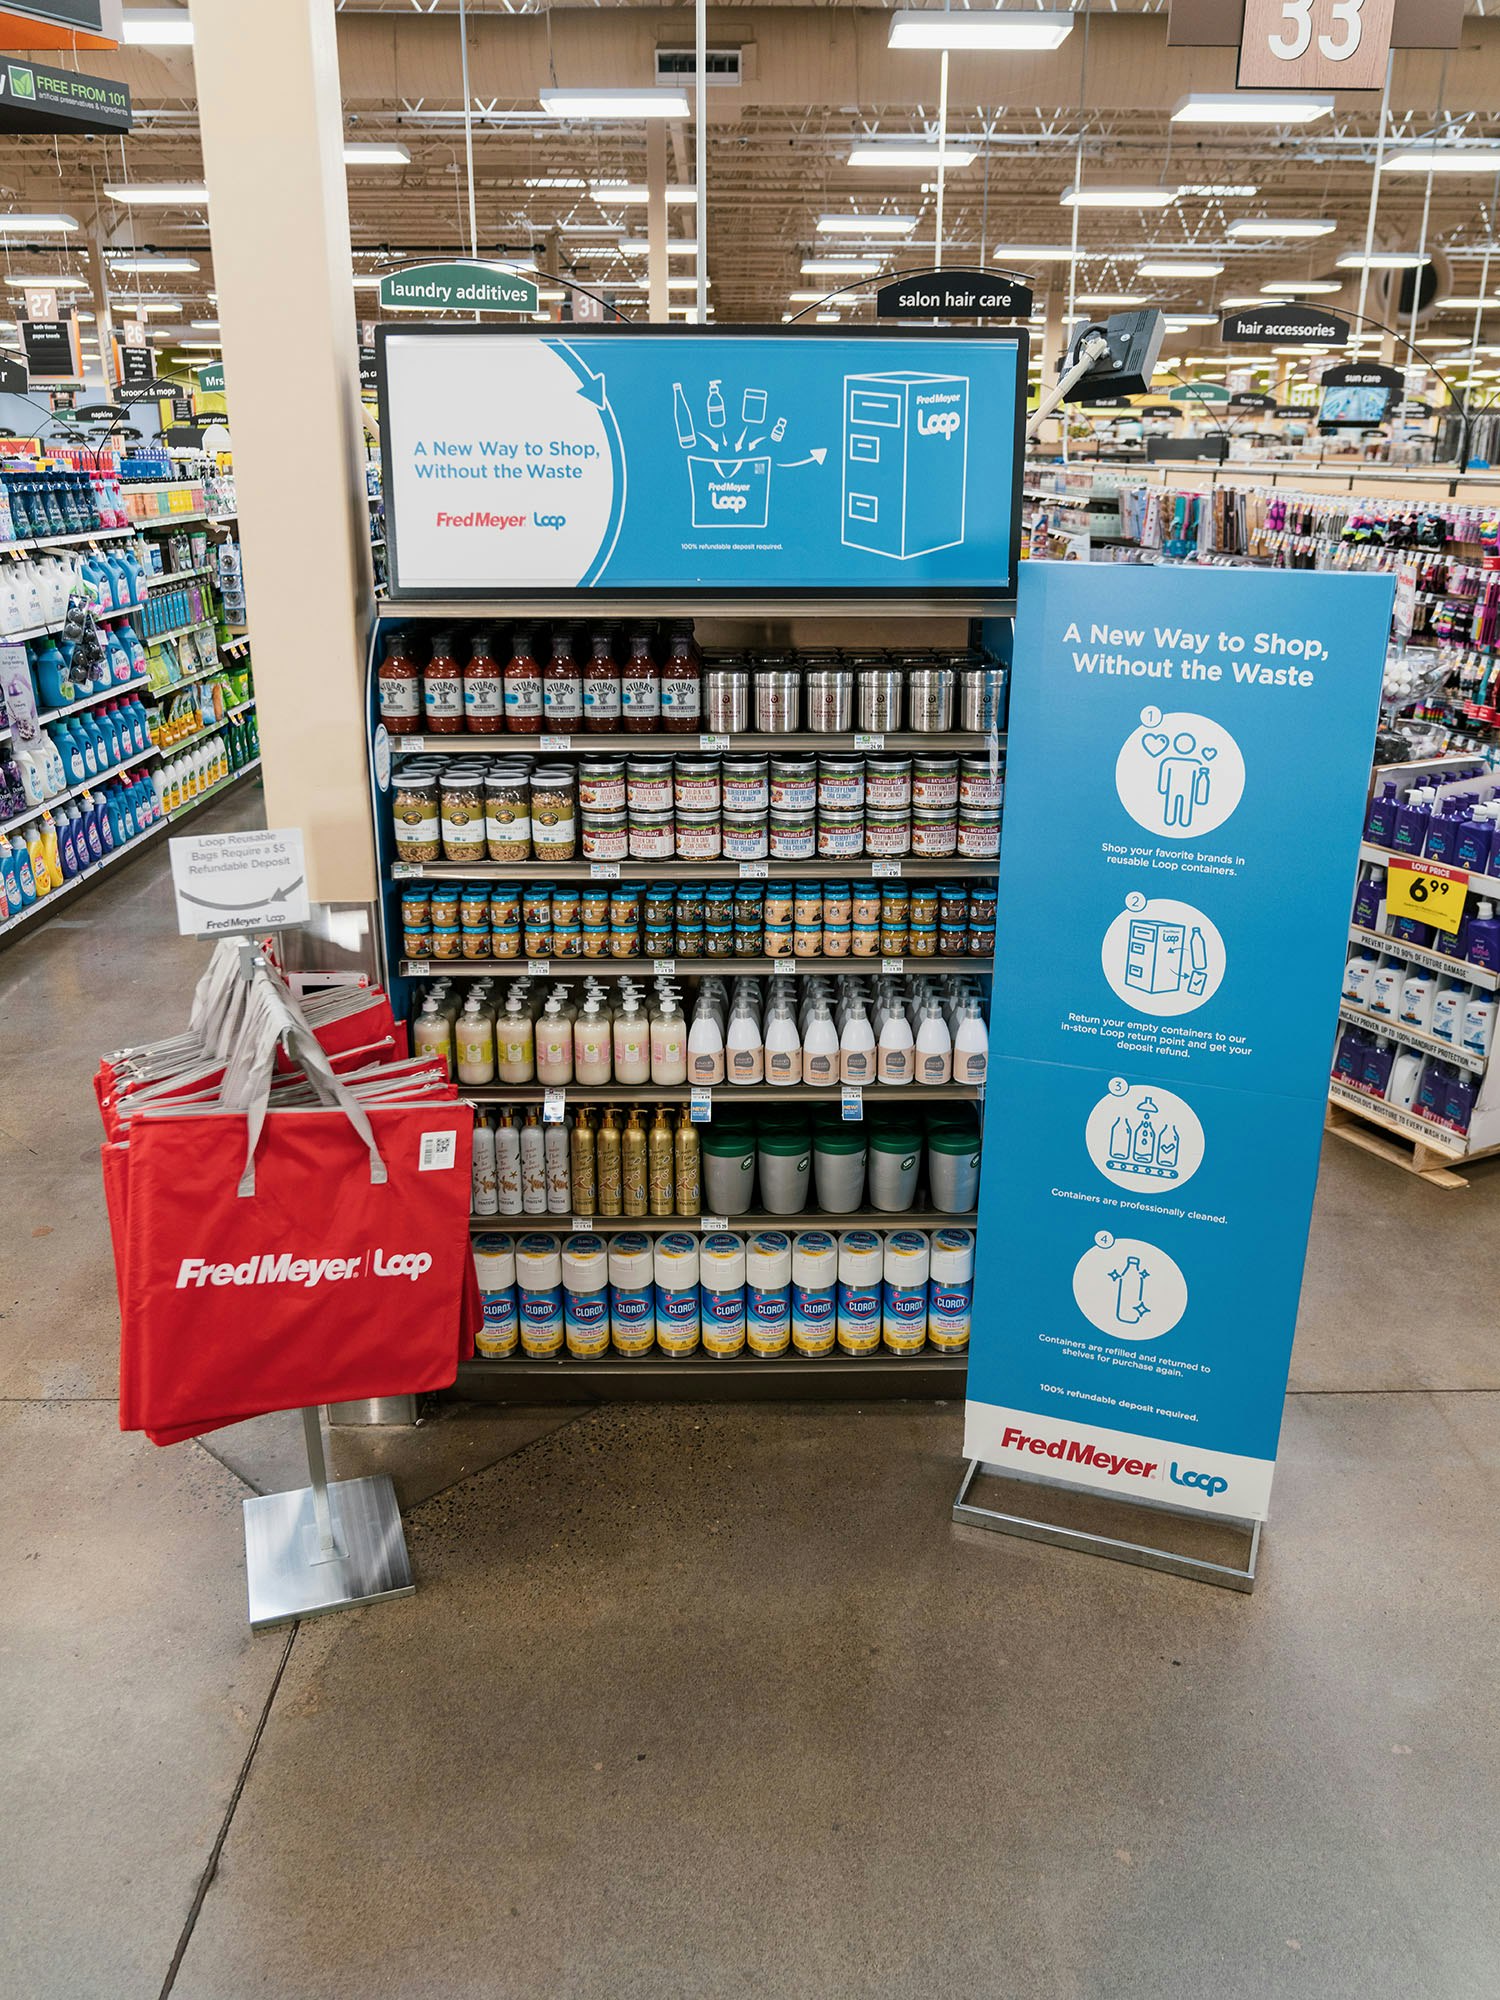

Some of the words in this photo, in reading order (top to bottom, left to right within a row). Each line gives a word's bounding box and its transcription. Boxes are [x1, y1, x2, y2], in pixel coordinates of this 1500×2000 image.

[37, 76, 69, 94] FREE
[71, 83, 106, 102] FROM
[109, 92, 126, 106] 101
[39, 92, 59, 102] artificial
[60, 97, 94, 109] preservatives
[100, 104, 128, 116] ingredients
[391, 281, 451, 300] laundry
[456, 284, 528, 302] additives
[899, 292, 940, 307] salon
[945, 292, 975, 307] hair
[979, 295, 1012, 308] care
[32, 294, 49, 317] 27
[579, 295, 599, 319] 31
[127, 325, 142, 343] 26
[1237, 321, 1263, 337] hair
[1266, 322, 1335, 338] accessories
[1345, 375, 1361, 383] sun
[1363, 375, 1381, 383] care
[121, 389, 147, 397] brooms
[156, 388, 176, 397] mops
[917, 409, 960, 440] Loop
[414, 442, 427, 456] A
[434, 442, 472, 456] New
[479, 442, 518, 459] Way
[524, 442, 543, 456] to
[549, 442, 600, 459] Shop,
[416, 464, 487, 478] Without
[494, 464, 522, 478] the
[527, 465, 582, 479] Waste
[712, 492, 746, 513] Loop
[534, 512, 566, 530] Loop
[1062, 623, 1081, 643] A
[1090, 624, 1145, 646] New
[1154, 627, 1210, 654] Way
[1218, 632, 1245, 652] to
[1253, 633, 1329, 661] Shop,
[1072, 653, 1173, 678] Without
[1181, 658, 1222, 681] the
[1232, 662, 1314, 687] Waste
[1148, 711, 1152, 722] 1
[200, 838, 225, 848] Loop
[229, 833, 276, 845] Reusable
[192, 851, 218, 862] Bags
[222, 847, 261, 858] Require
[273, 844, 285, 853] $5
[1102, 843, 1127, 855] Shop
[1130, 847, 1153, 856] your
[1156, 848, 1194, 860] favorite
[1197, 852, 1232, 864] brands
[1236, 856, 1245, 866] in
[189, 861, 248, 874] Refundable
[252, 857, 290, 869] Deposit
[1107, 856, 1149, 867] reusable
[1152, 860, 1178, 871] Loop
[1181, 862, 1237, 876] containers.
[1411, 862, 1427, 872] LOW
[1429, 866, 1450, 878] PRICE
[1132, 896, 1139, 907] 2
[266, 914, 285, 923] Loop
[1163, 933, 1179, 945] Loop
[1362, 936, 1384, 948] PREVENT
[1393, 947, 1400, 955] TO
[1422, 956, 1442, 970] FUTURE
[1068, 1012, 1100, 1024] Return
[1103, 1018, 1124, 1028] your
[1127, 1022, 1158, 1034] empty
[1162, 1026, 1212, 1039] containers
[1216, 1032, 1225, 1041] to
[1229, 1035, 1246, 1044] our
[1061, 1022, 1097, 1034] in-store
[1100, 1028, 1124, 1039] Loop
[1128, 1031, 1156, 1042] return
[1159, 1035, 1185, 1047] point
[1188, 1040, 1206, 1050] and
[1209, 1043, 1226, 1053] get
[1229, 1046, 1252, 1056] your
[1116, 1041, 1153, 1053] deposit
[1156, 1046, 1190, 1058] refund.
[1411, 1037, 1436, 1053] DANDRUFF
[1438, 1047, 1469, 1066] PROTECTION
[1115, 1081, 1121, 1092] 3
[1331, 1086, 1341, 1095] ADD
[1342, 1089, 1372, 1108] MIRACULOUS
[1373, 1104, 1398, 1121] MOISTURE
[1399, 1116, 1405, 1124] TO
[1406, 1119, 1423, 1131] EVERY
[1424, 1128, 1439, 1138] WASH
[1440, 1134, 1451, 1144] DAY
[1051, 1188, 1100, 1203] Containers
[1103, 1197, 1117, 1206] are
[1120, 1199, 1185, 1218] professionally
[1188, 1210, 1228, 1224] cleaned.
[1100, 1235, 1108, 1244] 4
[373, 1248, 432, 1280] Loop
[483, 1303, 511, 1314] CLOROX
[525, 1304, 553, 1314] CLOROX
[575, 1304, 603, 1317] CLOROX
[618, 1303, 646, 1313] CLOROX
[669, 1302, 696, 1314] CLOROX
[716, 1304, 742, 1315] CLOROX
[758, 1304, 786, 1314] CLOROX
[804, 1302, 832, 1313] CLOROX
[849, 1302, 876, 1311] CLOROX
[895, 1302, 922, 1311] CLOROX
[937, 1298, 965, 1308] CLOROX
[1039, 1333, 1086, 1349] Containers
[1088, 1343, 1103, 1353] are
[1105, 1346, 1136, 1359] refilled
[1138, 1352, 1156, 1363] and
[1159, 1357, 1198, 1371] returned
[1201, 1364, 1211, 1374] to
[1062, 1348, 1094, 1360] shelves
[1097, 1354, 1109, 1362] for
[1112, 1358, 1153, 1372] purchase
[1156, 1366, 1184, 1377] again.
[1040, 1383, 1064, 1395] 100%
[1066, 1390, 1116, 1405] refundable
[1119, 1400, 1154, 1413] deposit
[1156, 1407, 1199, 1422] required.
[1170, 1462, 1228, 1497] Loop
